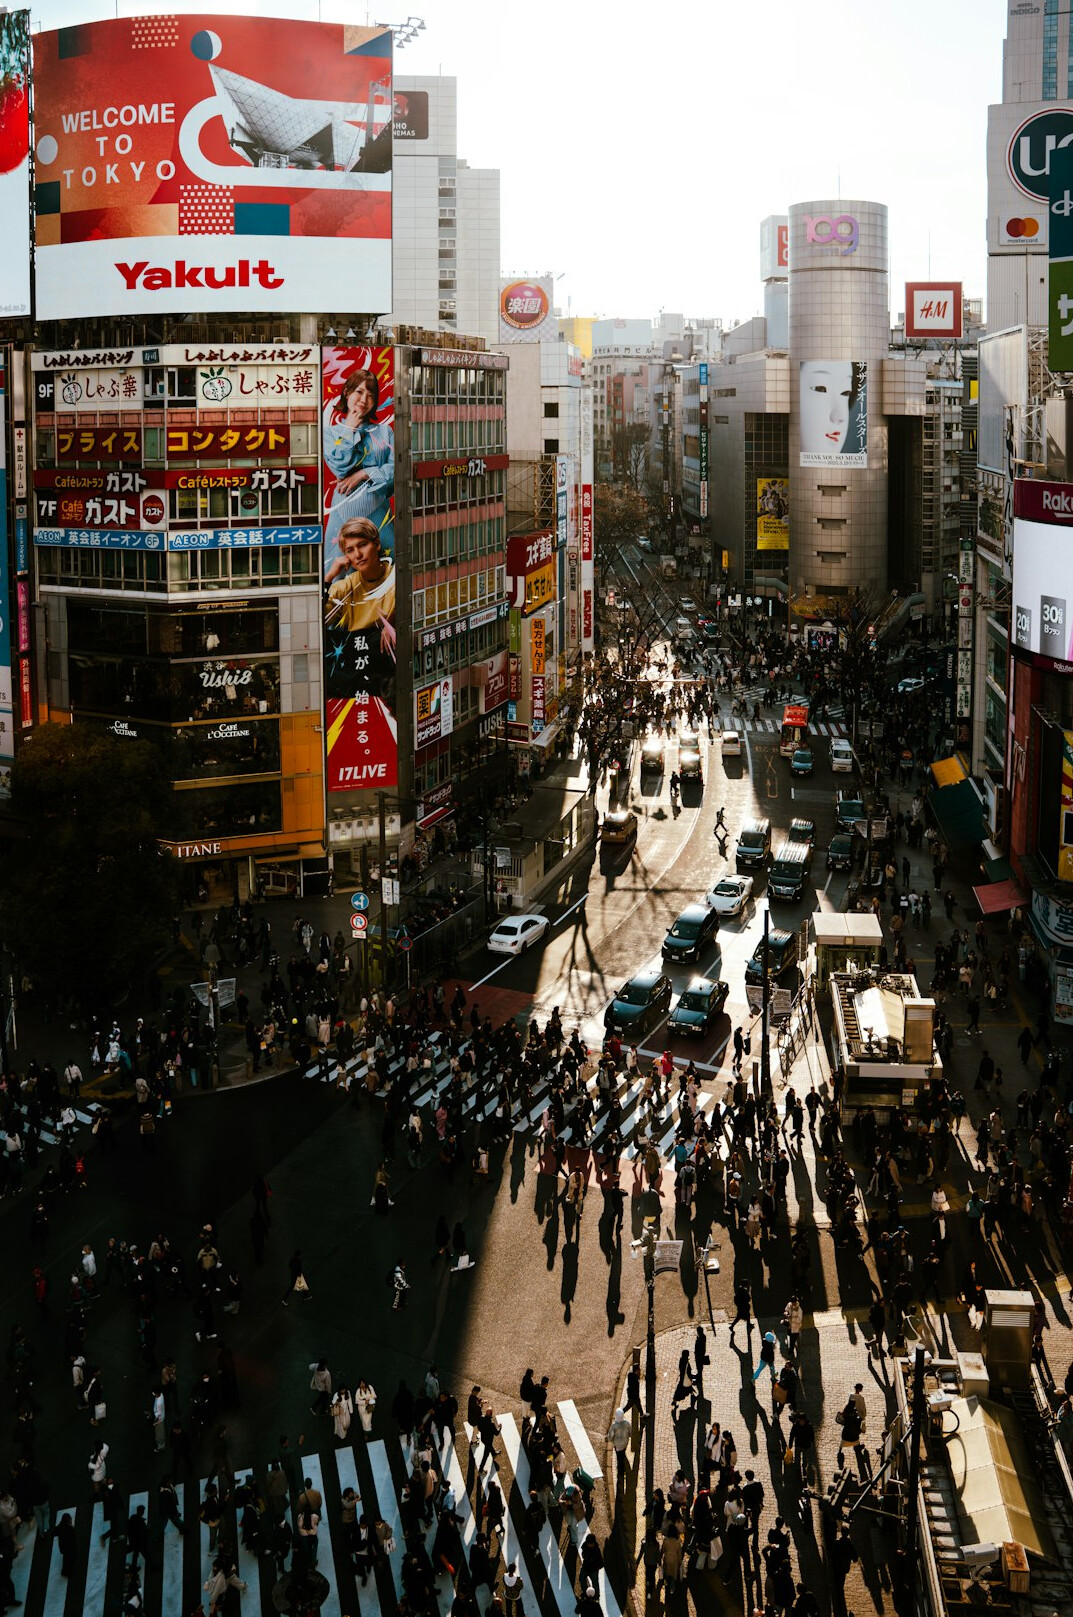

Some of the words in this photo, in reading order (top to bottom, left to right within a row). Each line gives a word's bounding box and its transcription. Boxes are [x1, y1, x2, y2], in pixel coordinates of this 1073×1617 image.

[62, 103, 175, 133] WELCOME
[393, 122, 407, 130] HO
[96, 134, 132, 157] TO
[63, 159, 176, 189] TOKYO
[803, 214, 860, 256] 109
[114, 260, 284, 290] Yakult
[508, 298, 541, 314] 楽園
[919, 300, 948, 319] H&M
[43, 350, 134, 368] しゃぶしゃぶバイキング
[184, 349, 312, 362] しゃぶしゃぶバイキング
[38, 383, 54, 398] 9F
[86, 374, 137, 398] しゃぶ葉
[239, 370, 313, 394] しゃぶ葉
[855, 362, 867, 454] サザンオールスターズ
[58, 431, 140, 454] プライス
[168, 428, 286, 451] コンタクト
[106, 471, 147, 493] ガスト
[251, 469, 305, 490] ガスト
[39, 500, 57, 517] 7F
[61, 500, 83, 513] Café
[85, 497, 136, 525] ガスト
[37, 532, 61, 543] AEON
[68, 531, 141, 546] 英会話イーオン
[147, 536, 158, 547] 6F
[174, 535, 208, 547] AEON
[217, 529, 319, 546] 英会話イーオン
[583, 514, 591, 553] TaxFree
[499, 603, 509, 618] 4F
[533, 620, 543, 658] 処方せん
[199, 669, 252, 687] Ushi8
[354, 636, 370, 755] 私が、始まる。
[418, 693, 429, 717] 薬
[533, 678, 543, 718] スギ薬局
[480, 710, 503, 737] LUSH
